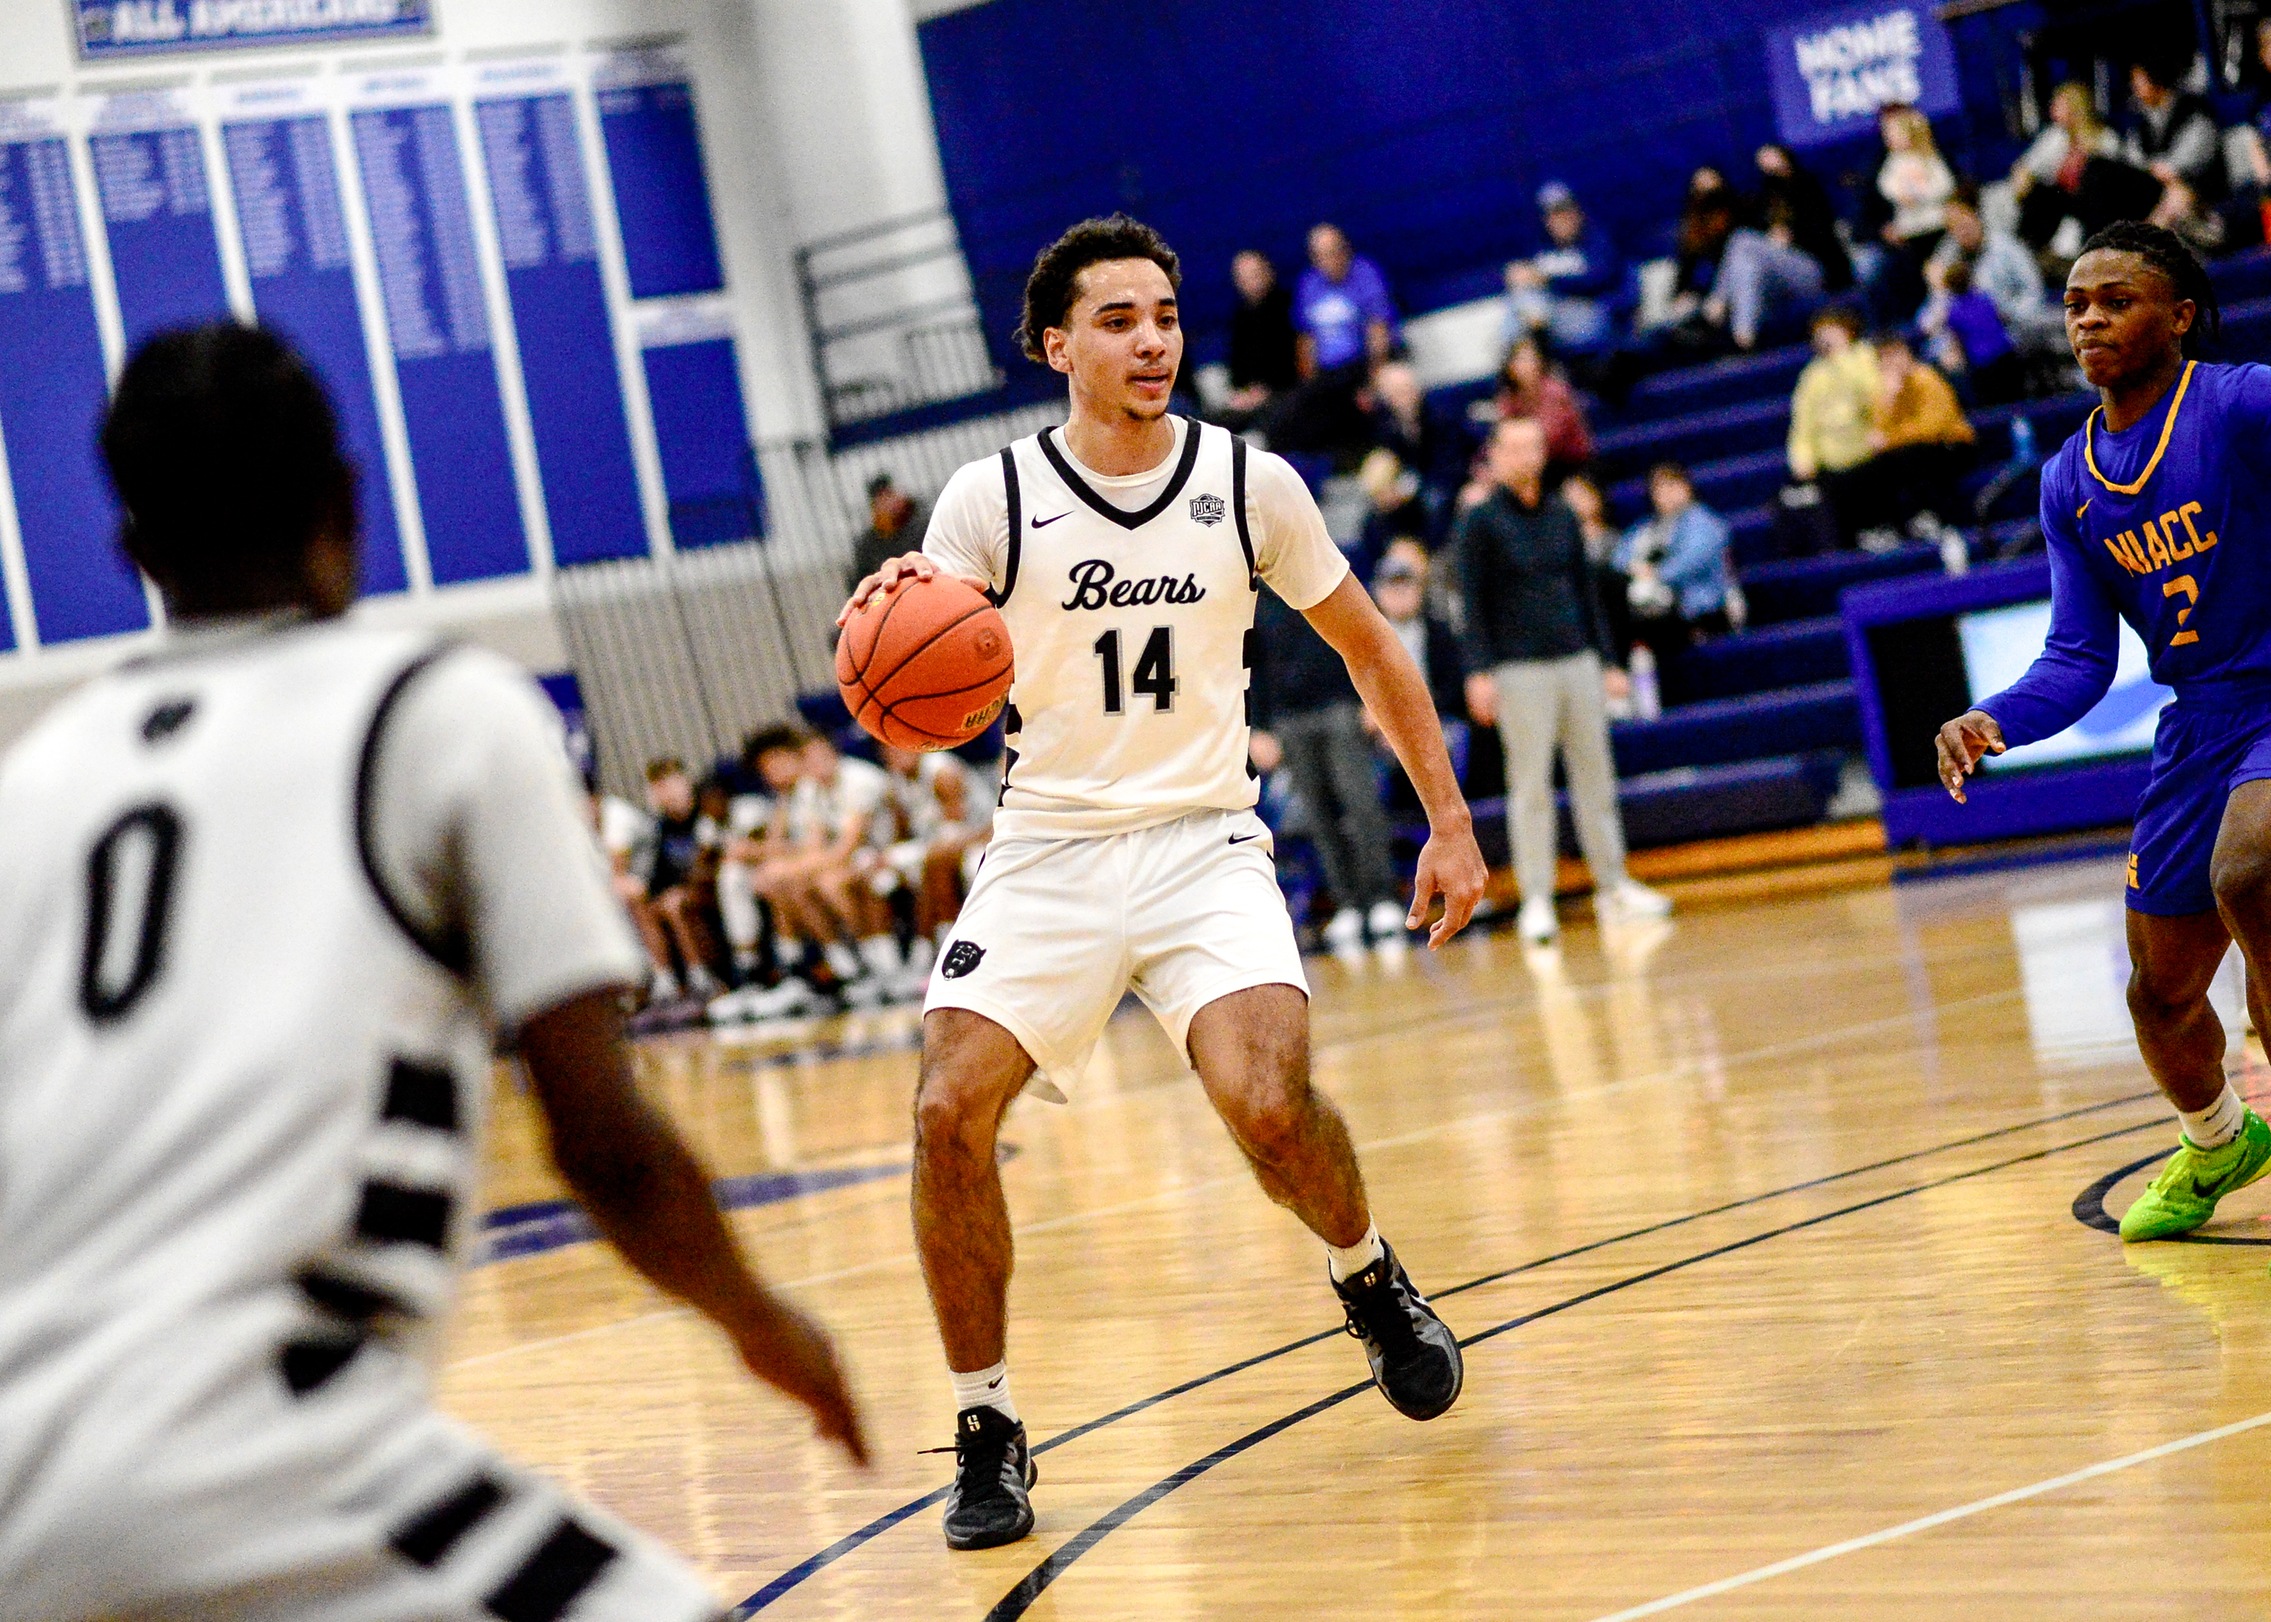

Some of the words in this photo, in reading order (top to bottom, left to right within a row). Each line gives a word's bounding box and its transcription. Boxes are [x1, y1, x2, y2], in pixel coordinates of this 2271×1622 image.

[1192, 501, 1221, 517] NJCAA
[2104, 501, 2218, 578] NIACC
[1061, 558, 1206, 611] Bears
[2162, 574, 2200, 647] 2
[1092, 625, 1180, 717] 14
[77, 801, 187, 1028] 0
